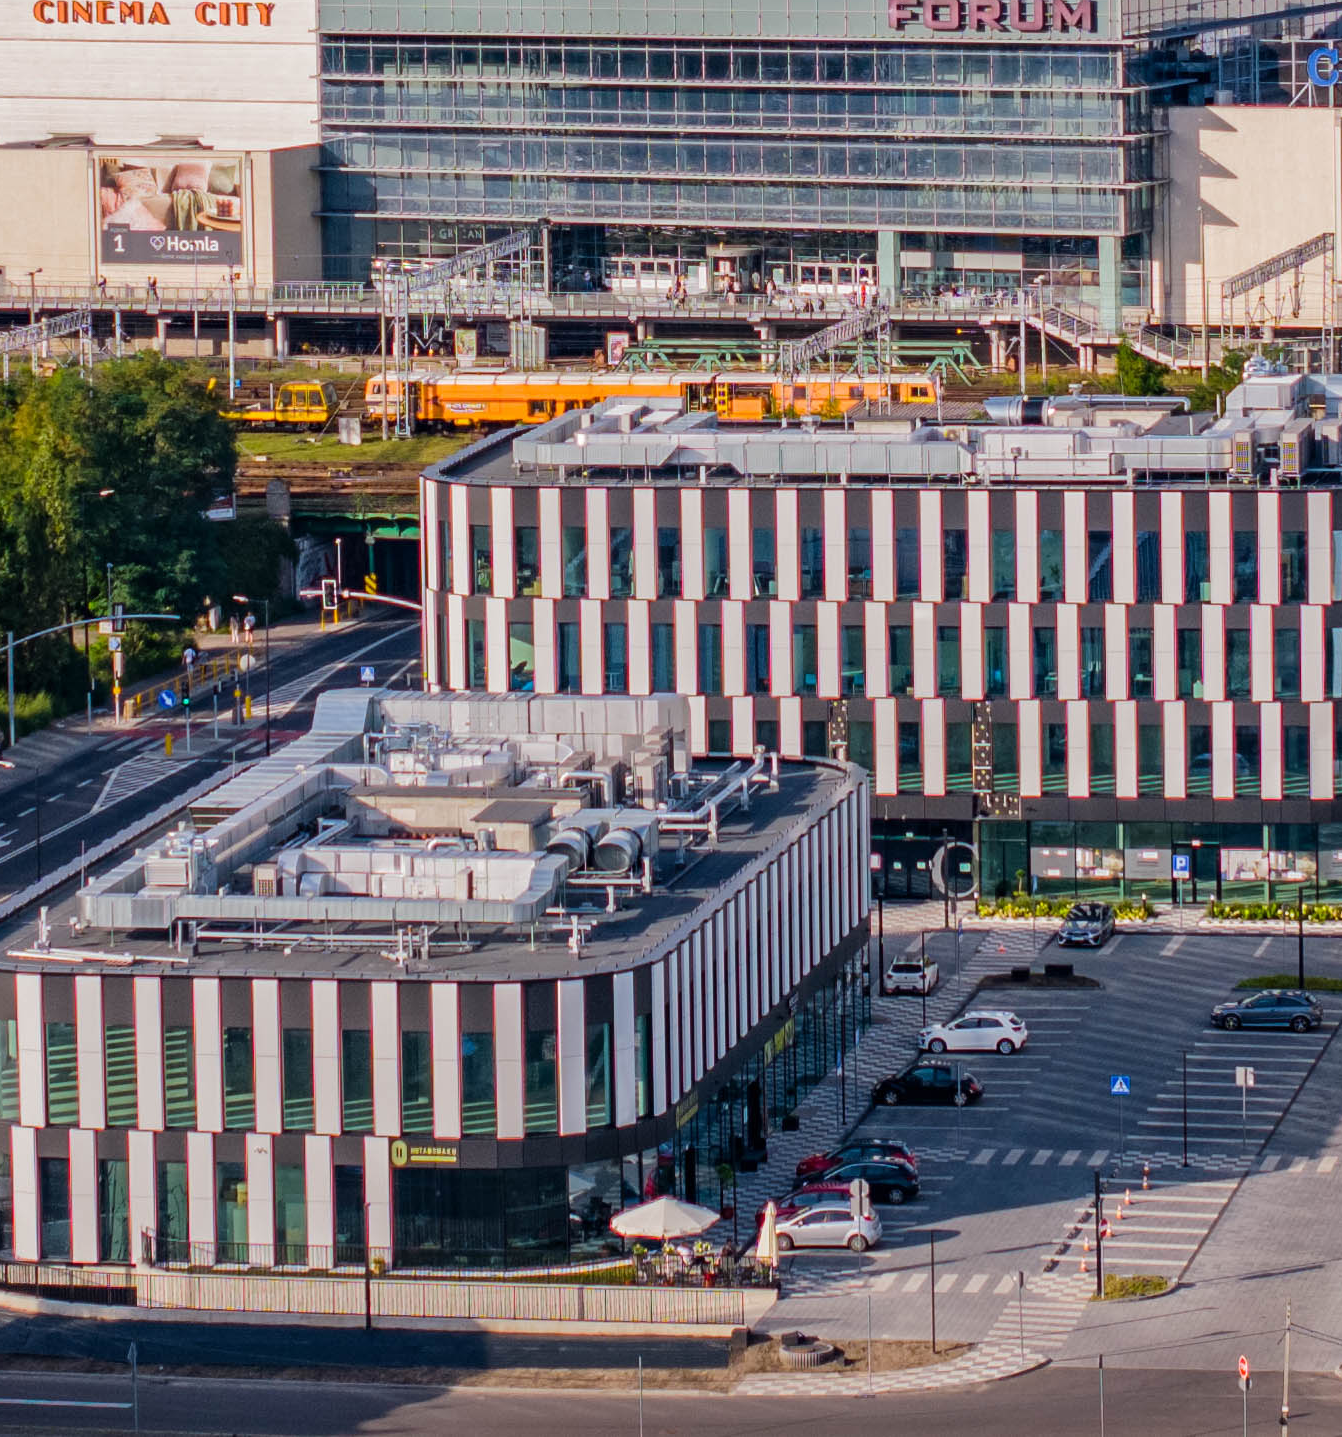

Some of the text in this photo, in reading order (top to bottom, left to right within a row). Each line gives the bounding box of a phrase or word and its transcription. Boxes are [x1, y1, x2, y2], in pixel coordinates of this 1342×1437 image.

[32, 0, 276, 27] CINEMA CITY
[113, 234, 219, 252] 1 Homla
[1175, 855, 1186, 870] P
